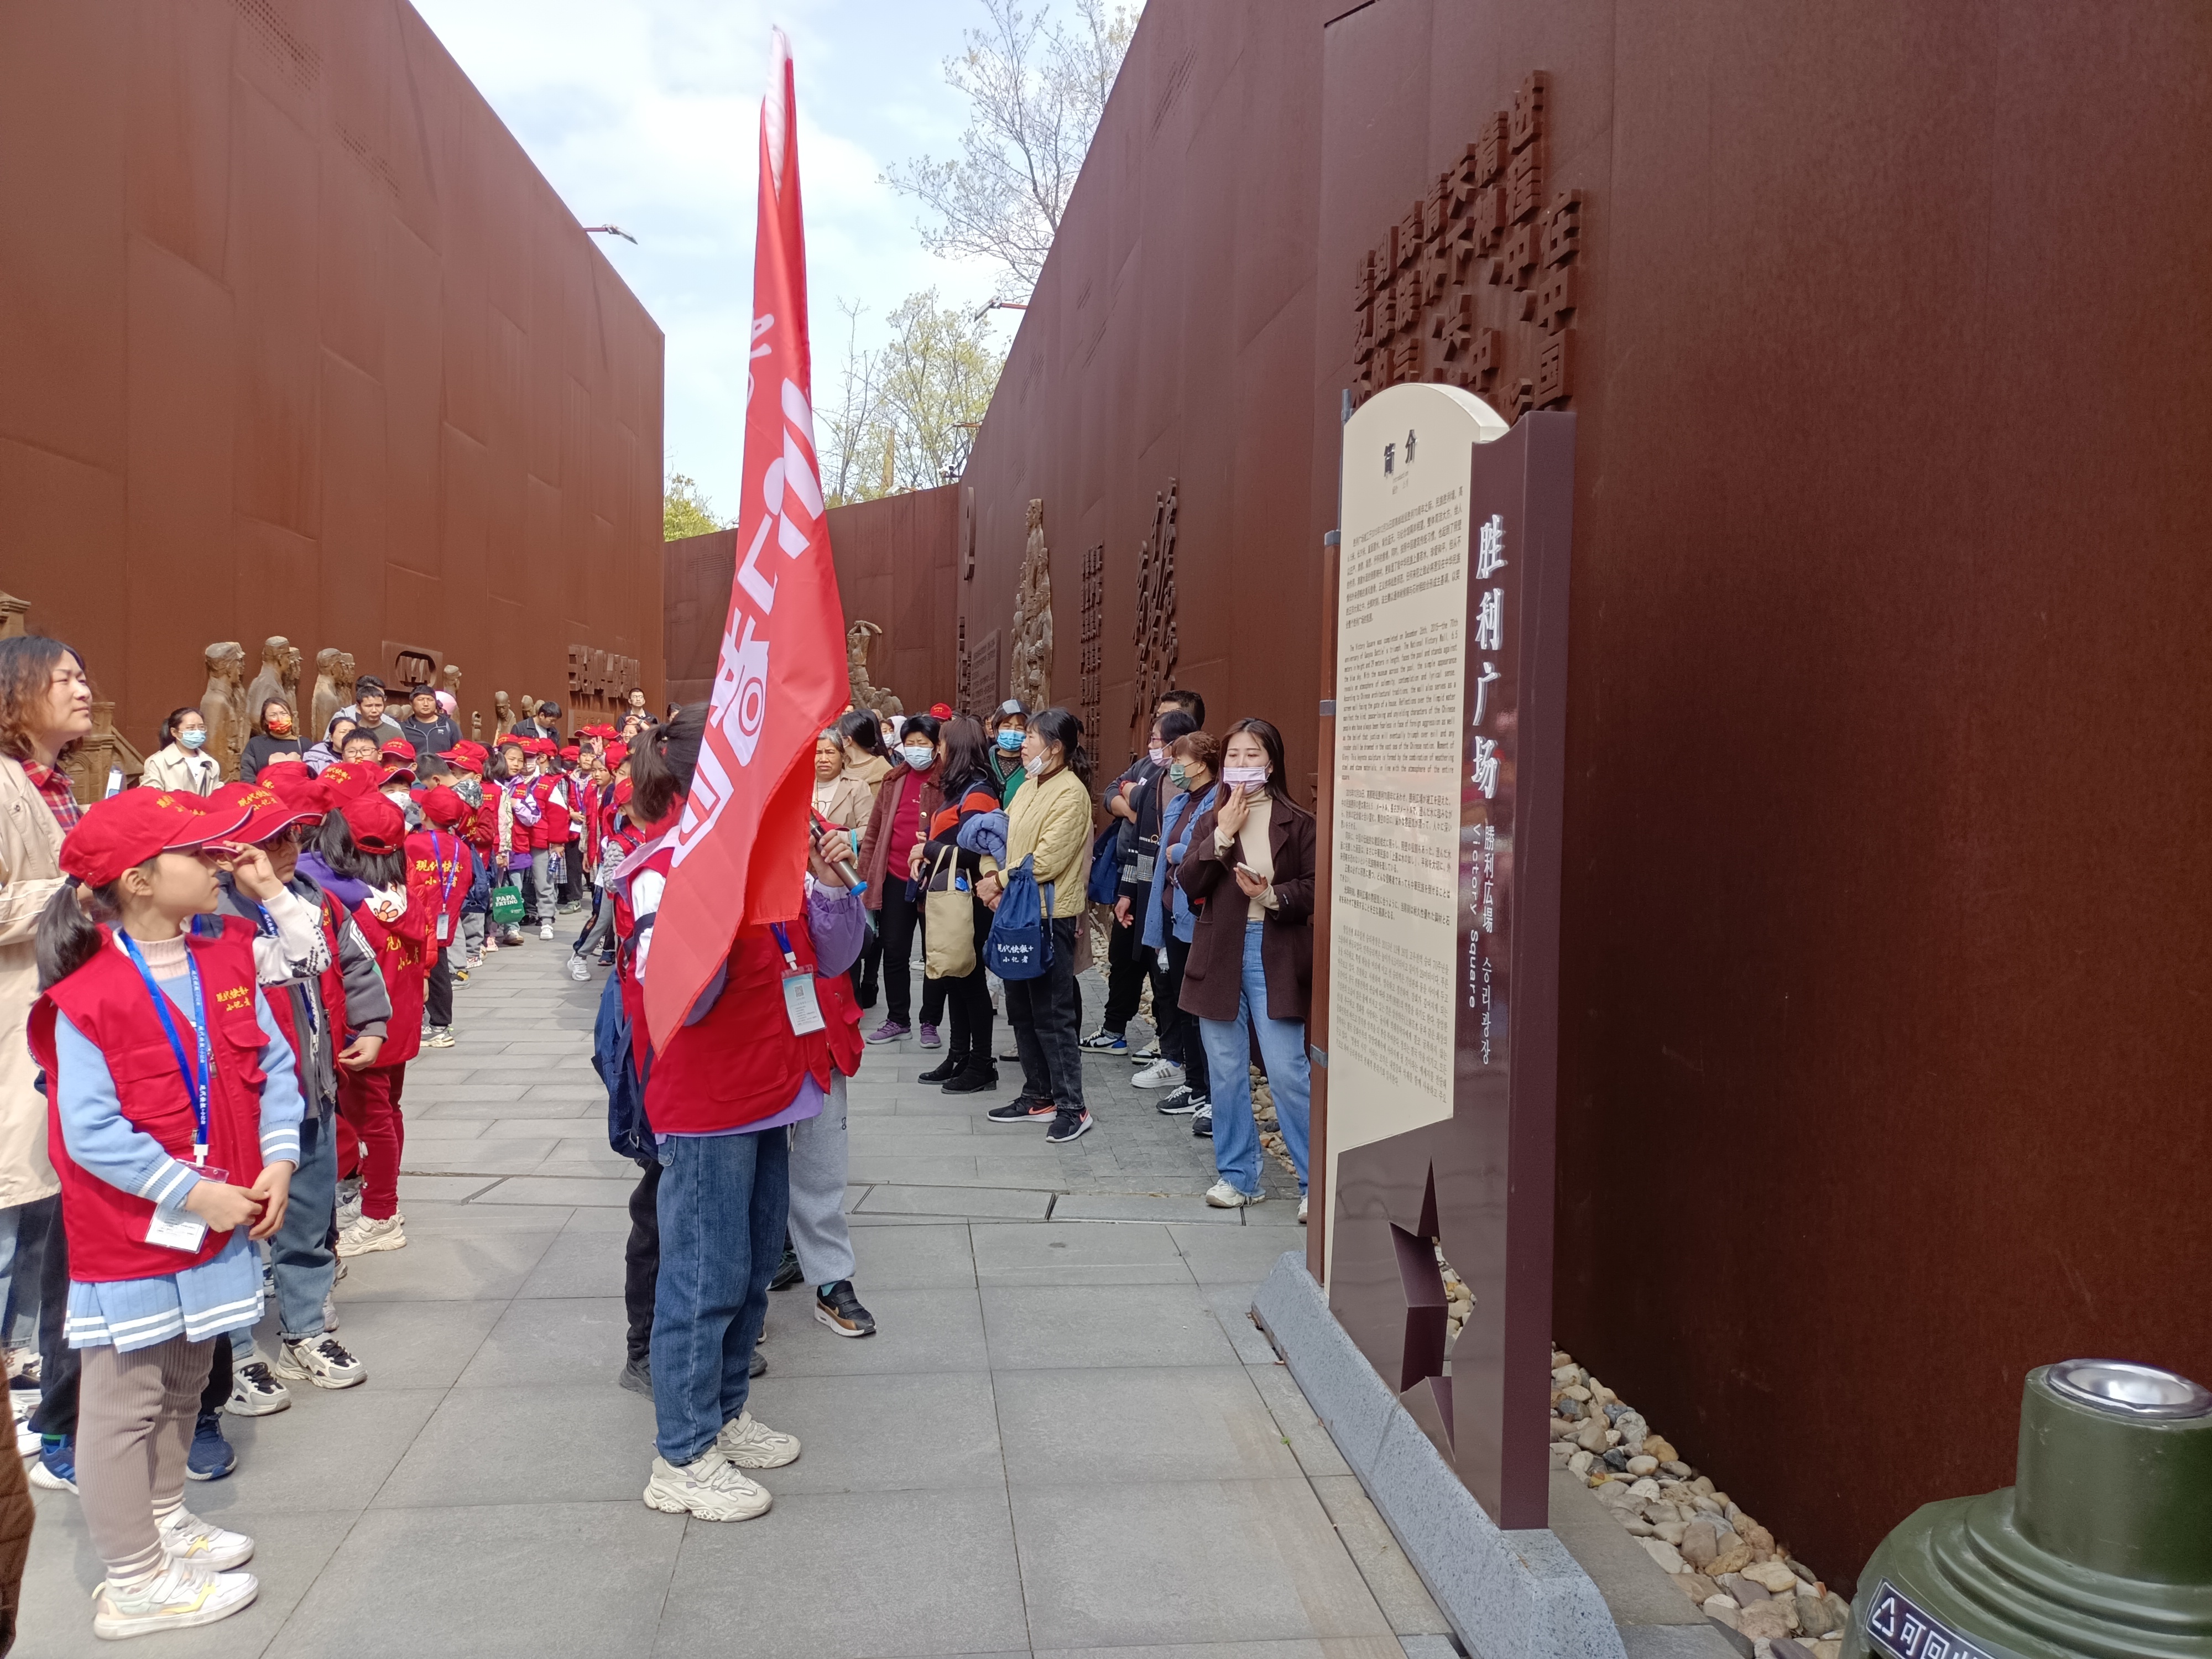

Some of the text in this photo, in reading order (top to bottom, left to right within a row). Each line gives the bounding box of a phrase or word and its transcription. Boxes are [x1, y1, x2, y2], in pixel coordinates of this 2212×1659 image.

[1384, 429, 1418, 478] 简介
[1472, 514, 1508, 800] 胜利广场
[495, 894, 517, 902] PAPA
[1468, 825, 1481, 1009] Victory Square
[1483, 826, 1495, 933] 勝利広場
[1003, 955, 1029, 964] 小记者
[1480, 957, 1493, 1065] 승리광장
